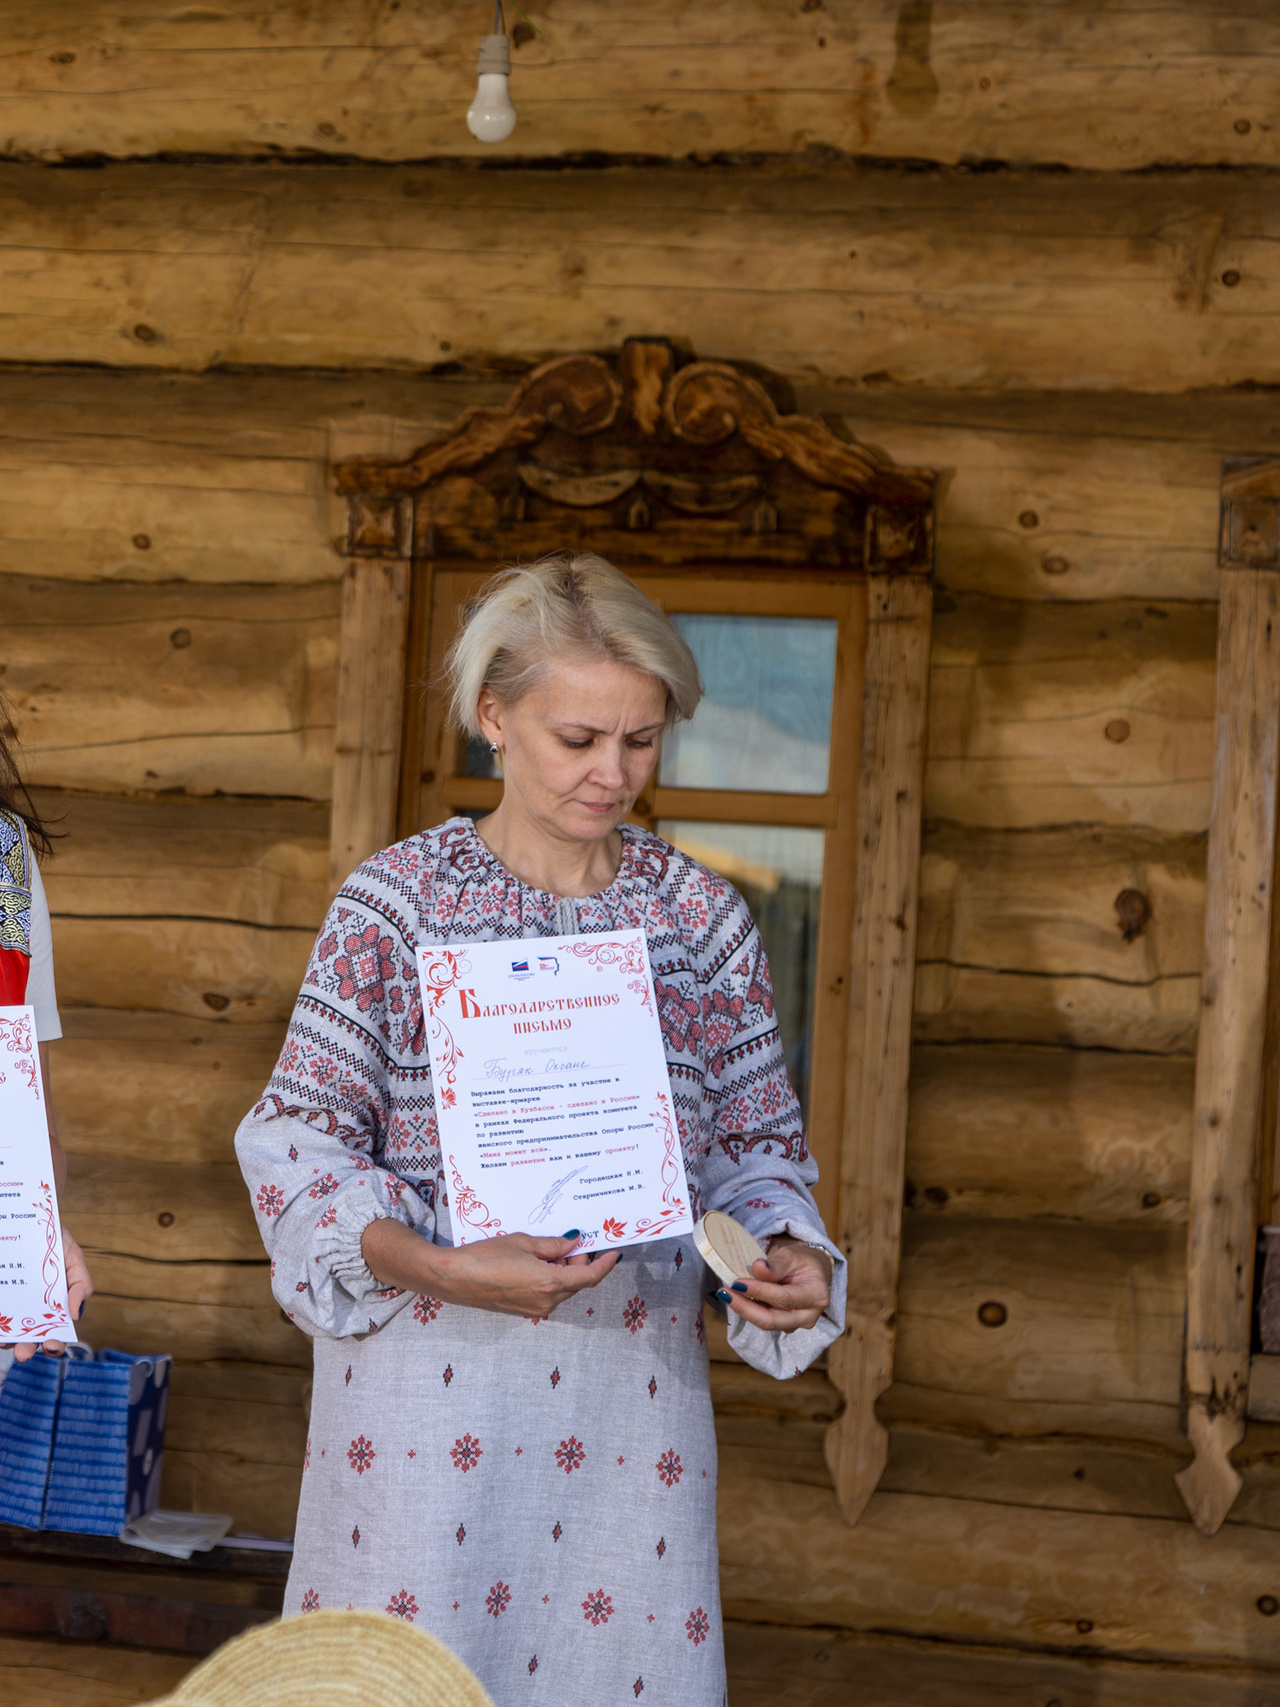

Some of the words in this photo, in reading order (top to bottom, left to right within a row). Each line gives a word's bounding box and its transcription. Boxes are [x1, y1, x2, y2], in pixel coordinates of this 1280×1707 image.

[509, 1084, 564, 1093] благодарность
[581, 1079, 611, 1087] участие
[472, 1097, 540, 1107] выставке-ярмарке
[610, 1095, 640, 1103] России»
[483, 1120, 510, 1128] рамках
[513, 1115, 565, 1124] Федерального
[569, 1110, 599, 1119] проекта
[603, 1105, 638, 1114] комитета
[489, 1129, 524, 1138] развитию
[516, 1131, 598, 1145] предпринимательства
[628, 1123, 654, 1131] России
[510, 1158, 546, 1167] развития
[575, 1150, 601, 1158] вашему
[605, 1144, 639, 1154] проекту!
[579, 1173, 623, 1184] Городецкая
[573, 1188, 625, 1200] Старинчикова
